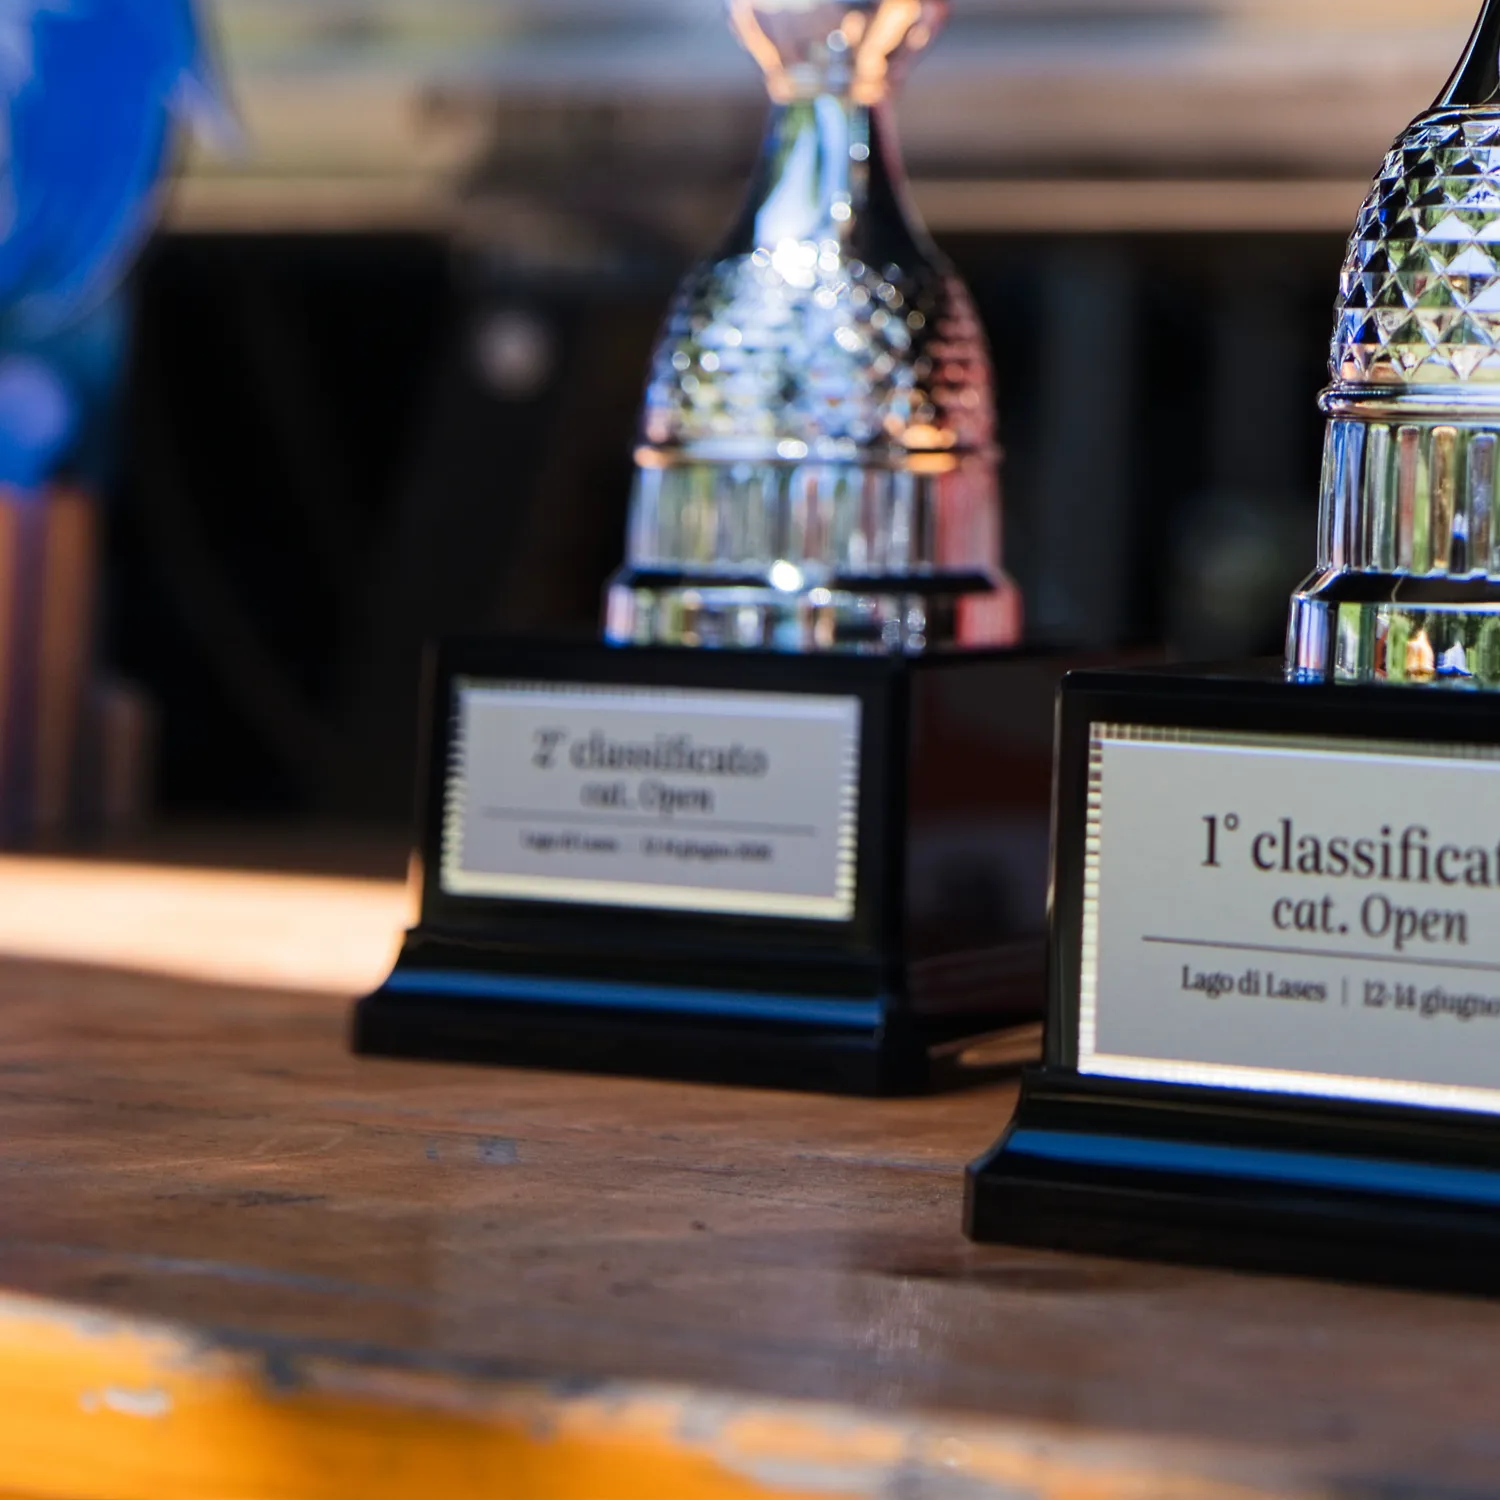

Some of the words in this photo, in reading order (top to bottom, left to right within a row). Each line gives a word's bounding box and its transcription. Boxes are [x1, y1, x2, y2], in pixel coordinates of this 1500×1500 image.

[1200, 812, 1240, 868] 1°
[1271, 894, 1349, 935] cat.
[1360, 892, 1469, 951] Open
[1181, 963, 1235, 1000] Lago
[1237, 967, 1261, 997] di
[1265, 971, 1327, 1004] Lases
[1363, 978, 1417, 1010] 12-14
